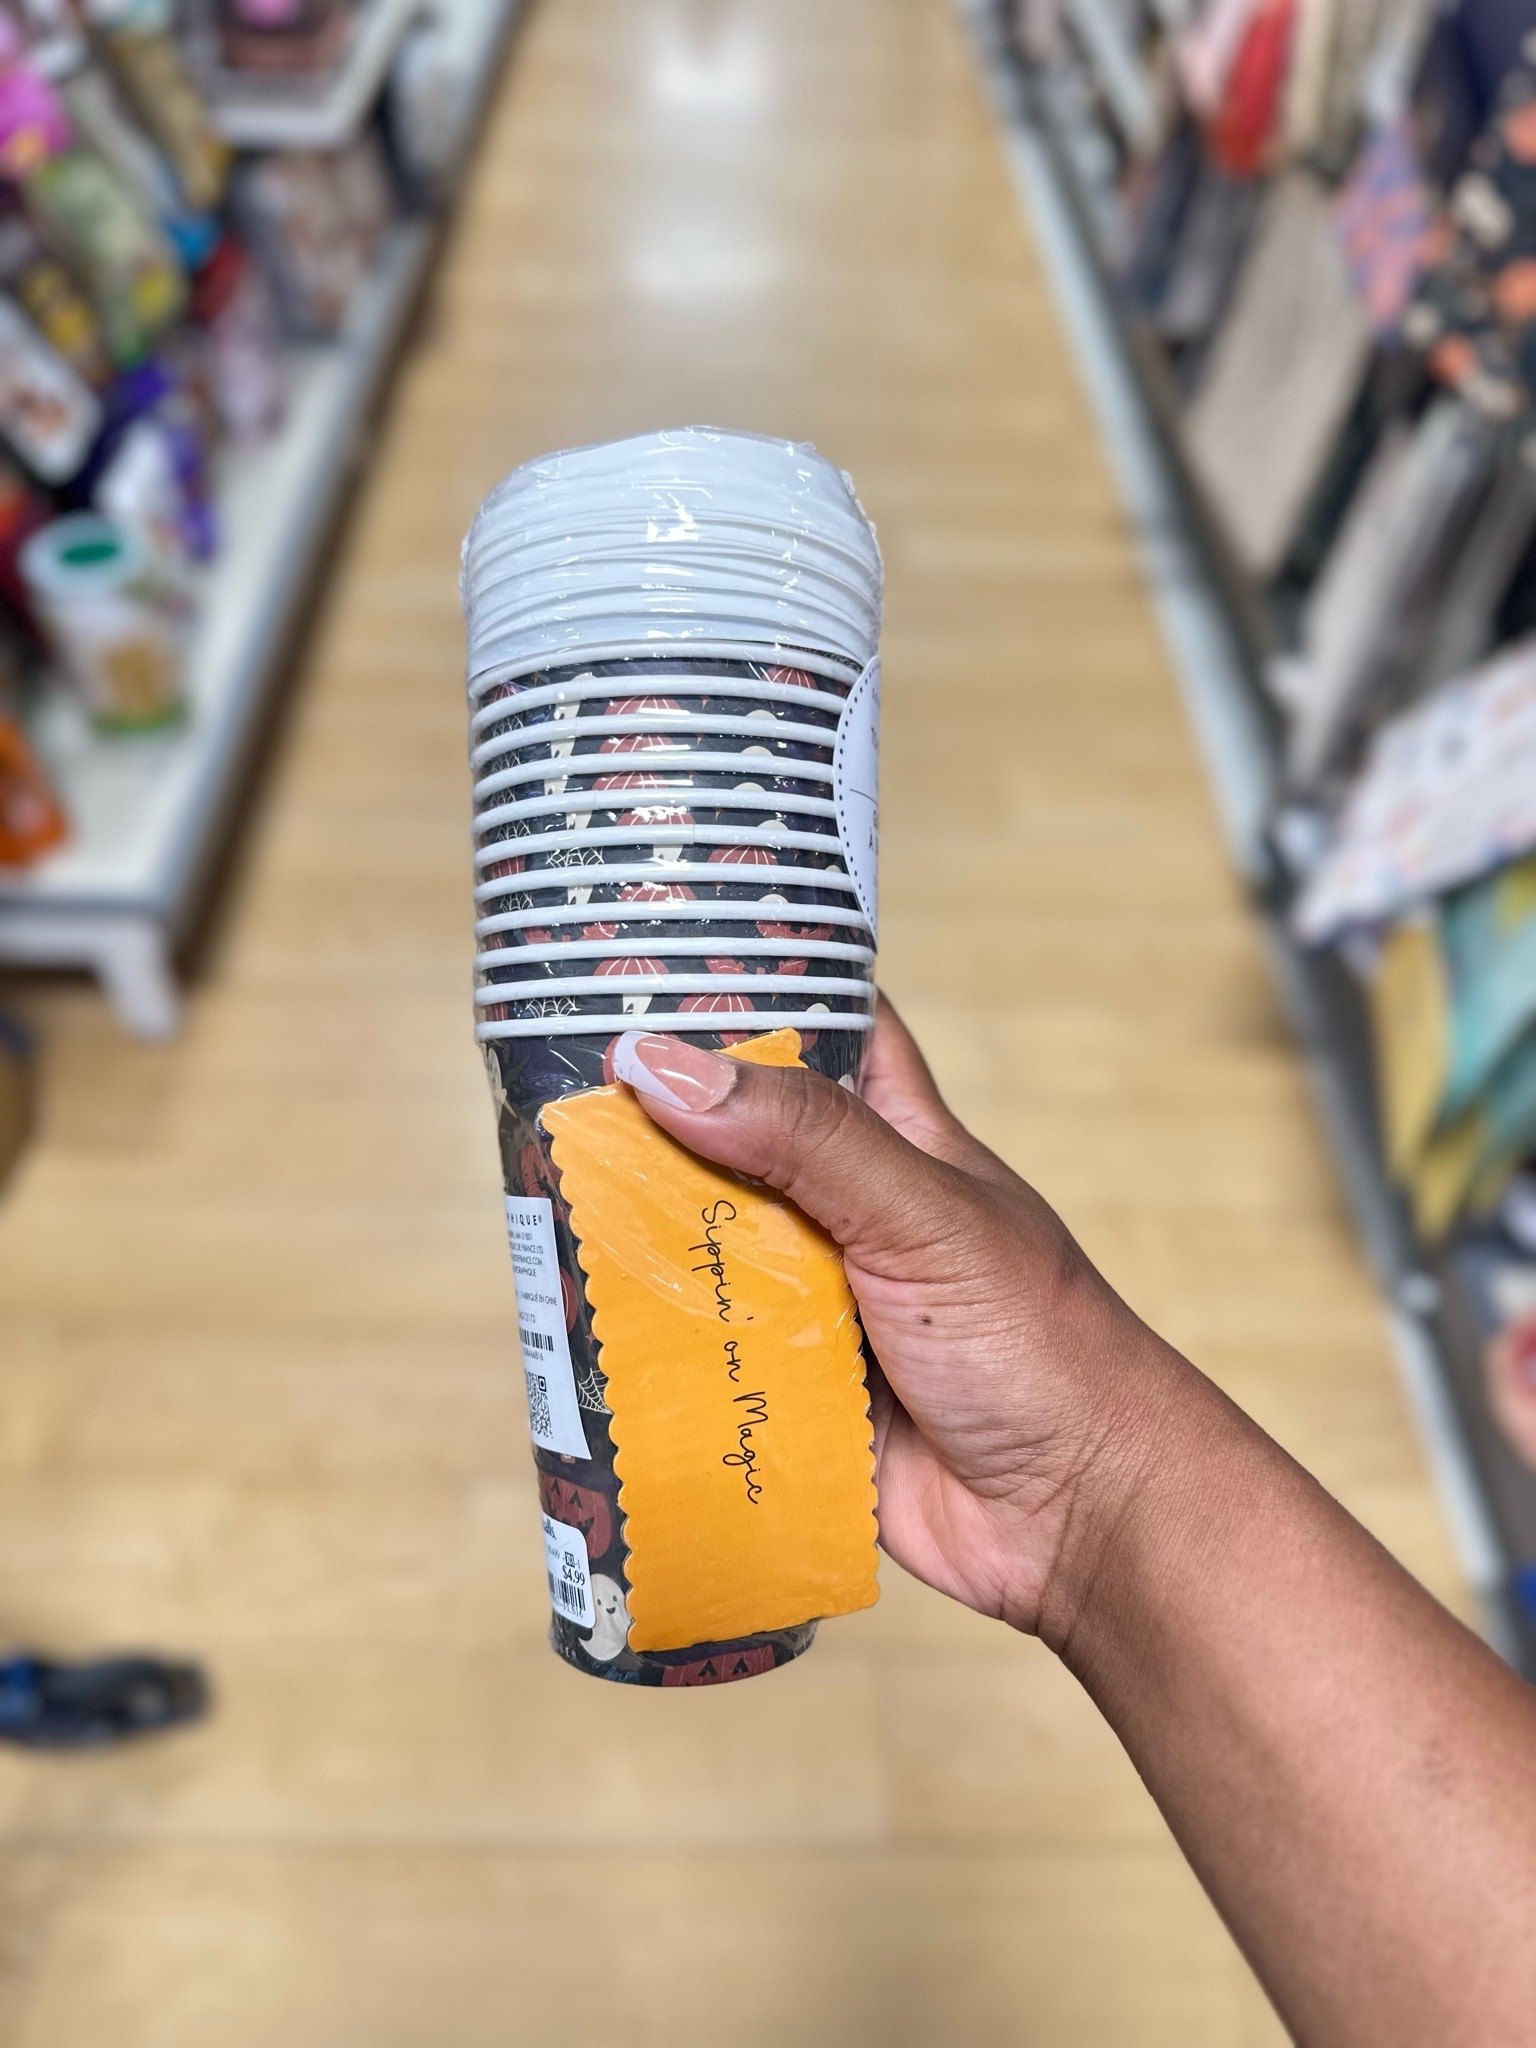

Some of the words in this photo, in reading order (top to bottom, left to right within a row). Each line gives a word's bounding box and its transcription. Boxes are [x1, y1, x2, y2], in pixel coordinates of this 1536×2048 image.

[688, 1200, 754, 1322] Sippin'
[723, 1341, 741, 1382] on
[722, 1391, 769, 1504] Magic
[562, 1565, 586, 1586] $4.99
